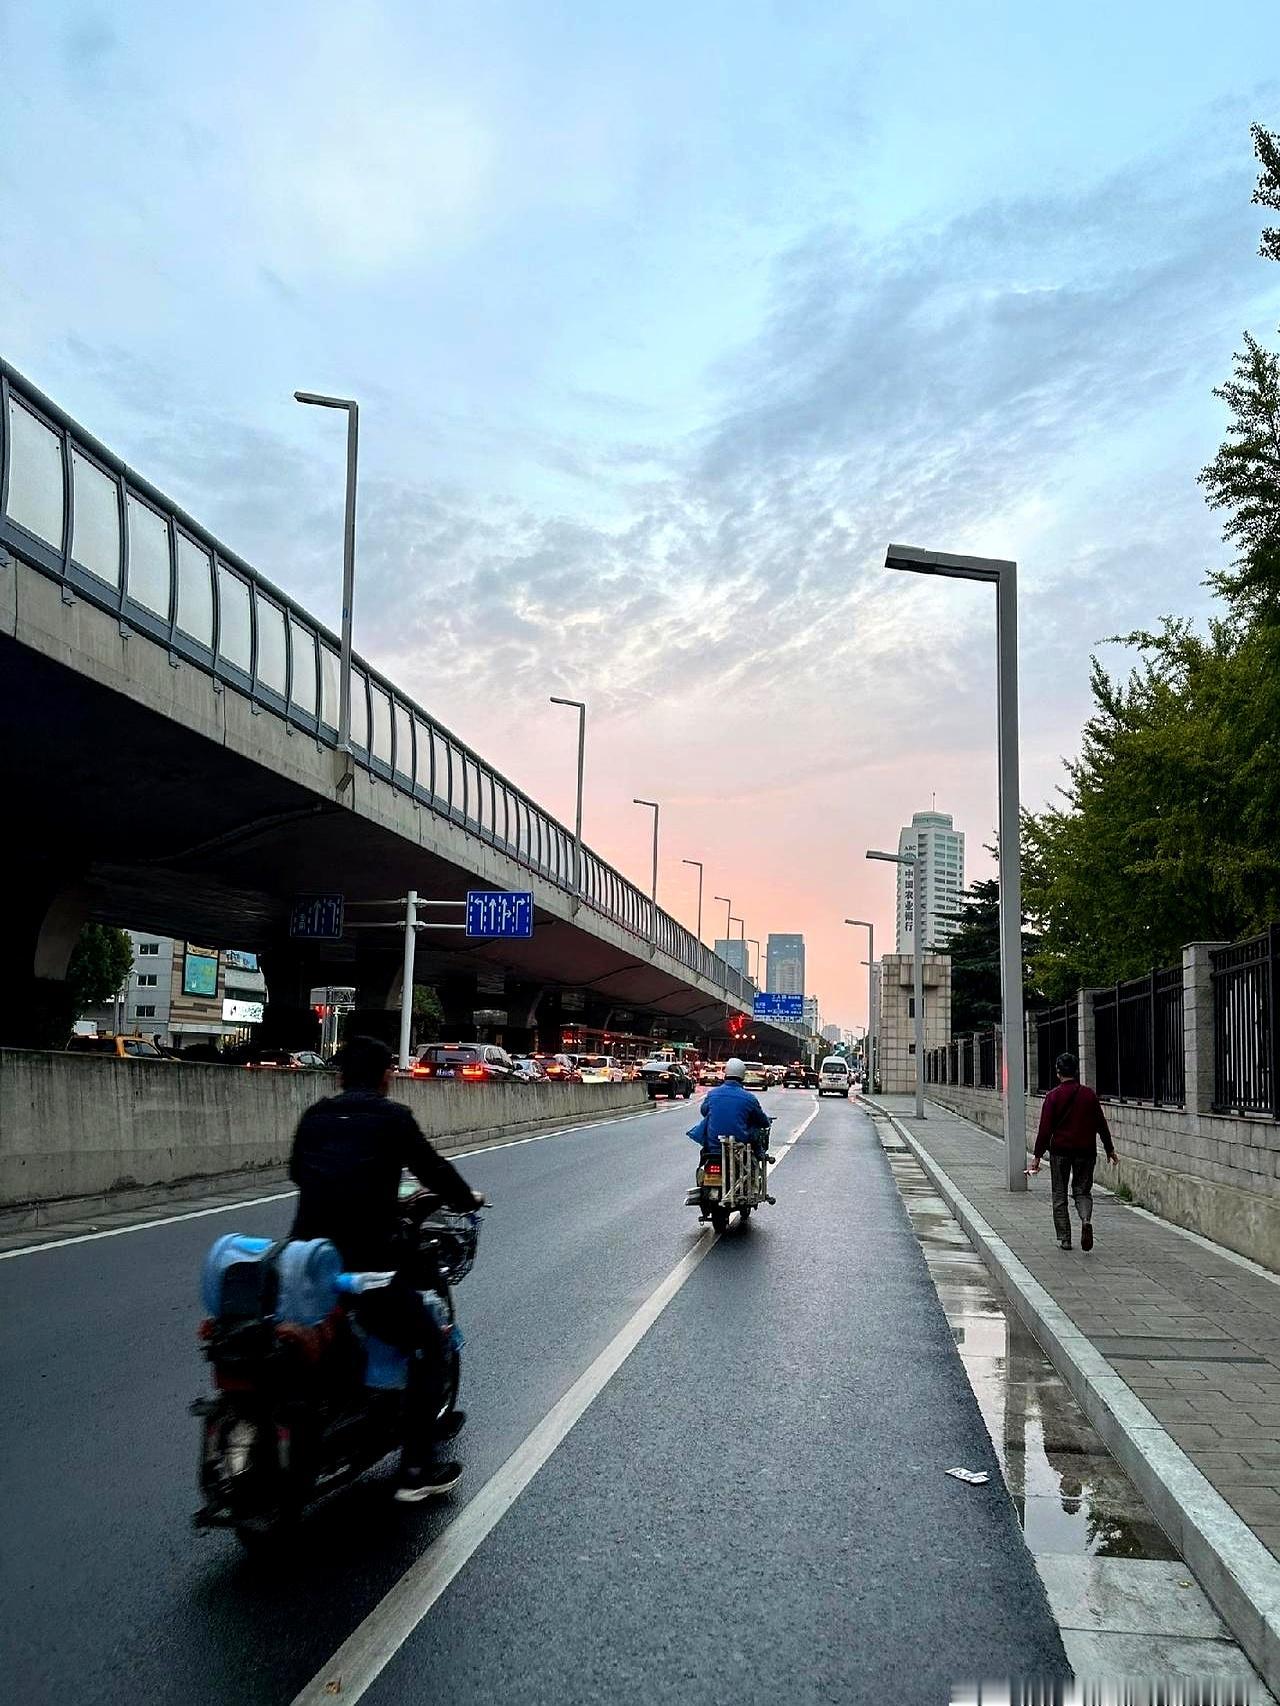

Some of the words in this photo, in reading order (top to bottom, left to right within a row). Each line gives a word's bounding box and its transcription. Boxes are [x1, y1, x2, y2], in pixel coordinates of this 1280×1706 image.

[905, 869, 914, 932] 中国农业银行
